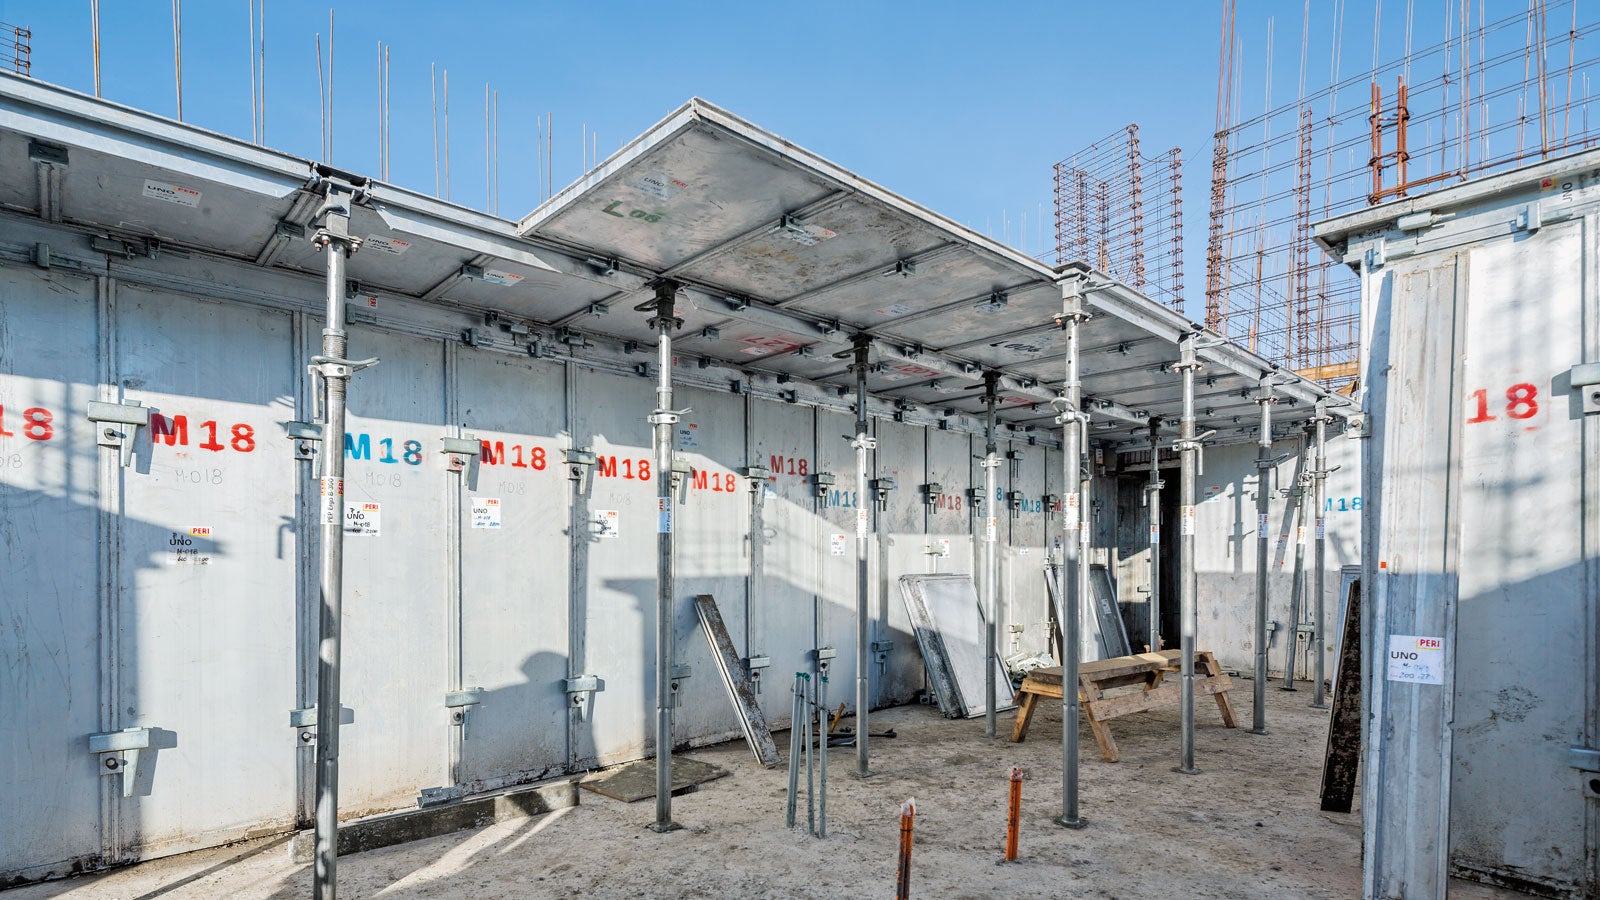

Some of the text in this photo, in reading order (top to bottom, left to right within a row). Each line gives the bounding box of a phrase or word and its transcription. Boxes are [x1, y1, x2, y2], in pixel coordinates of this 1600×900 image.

[1466, 382, 1540, 425] 18
[151, 413, 256, 453] M18
[344, 432, 423, 466] M18
[481, 440, 547, 471] M18
[597, 455, 651, 482] M18
[770, 455, 808, 477] M18
[692, 469, 736, 493] M18
[937, 494, 962, 511] M18
[169, 538, 193, 546] UNO
[192, 527, 210, 535] PERI
[1419, 639, 1441, 648] PERI
[1390, 650, 1419, 661] UNO
